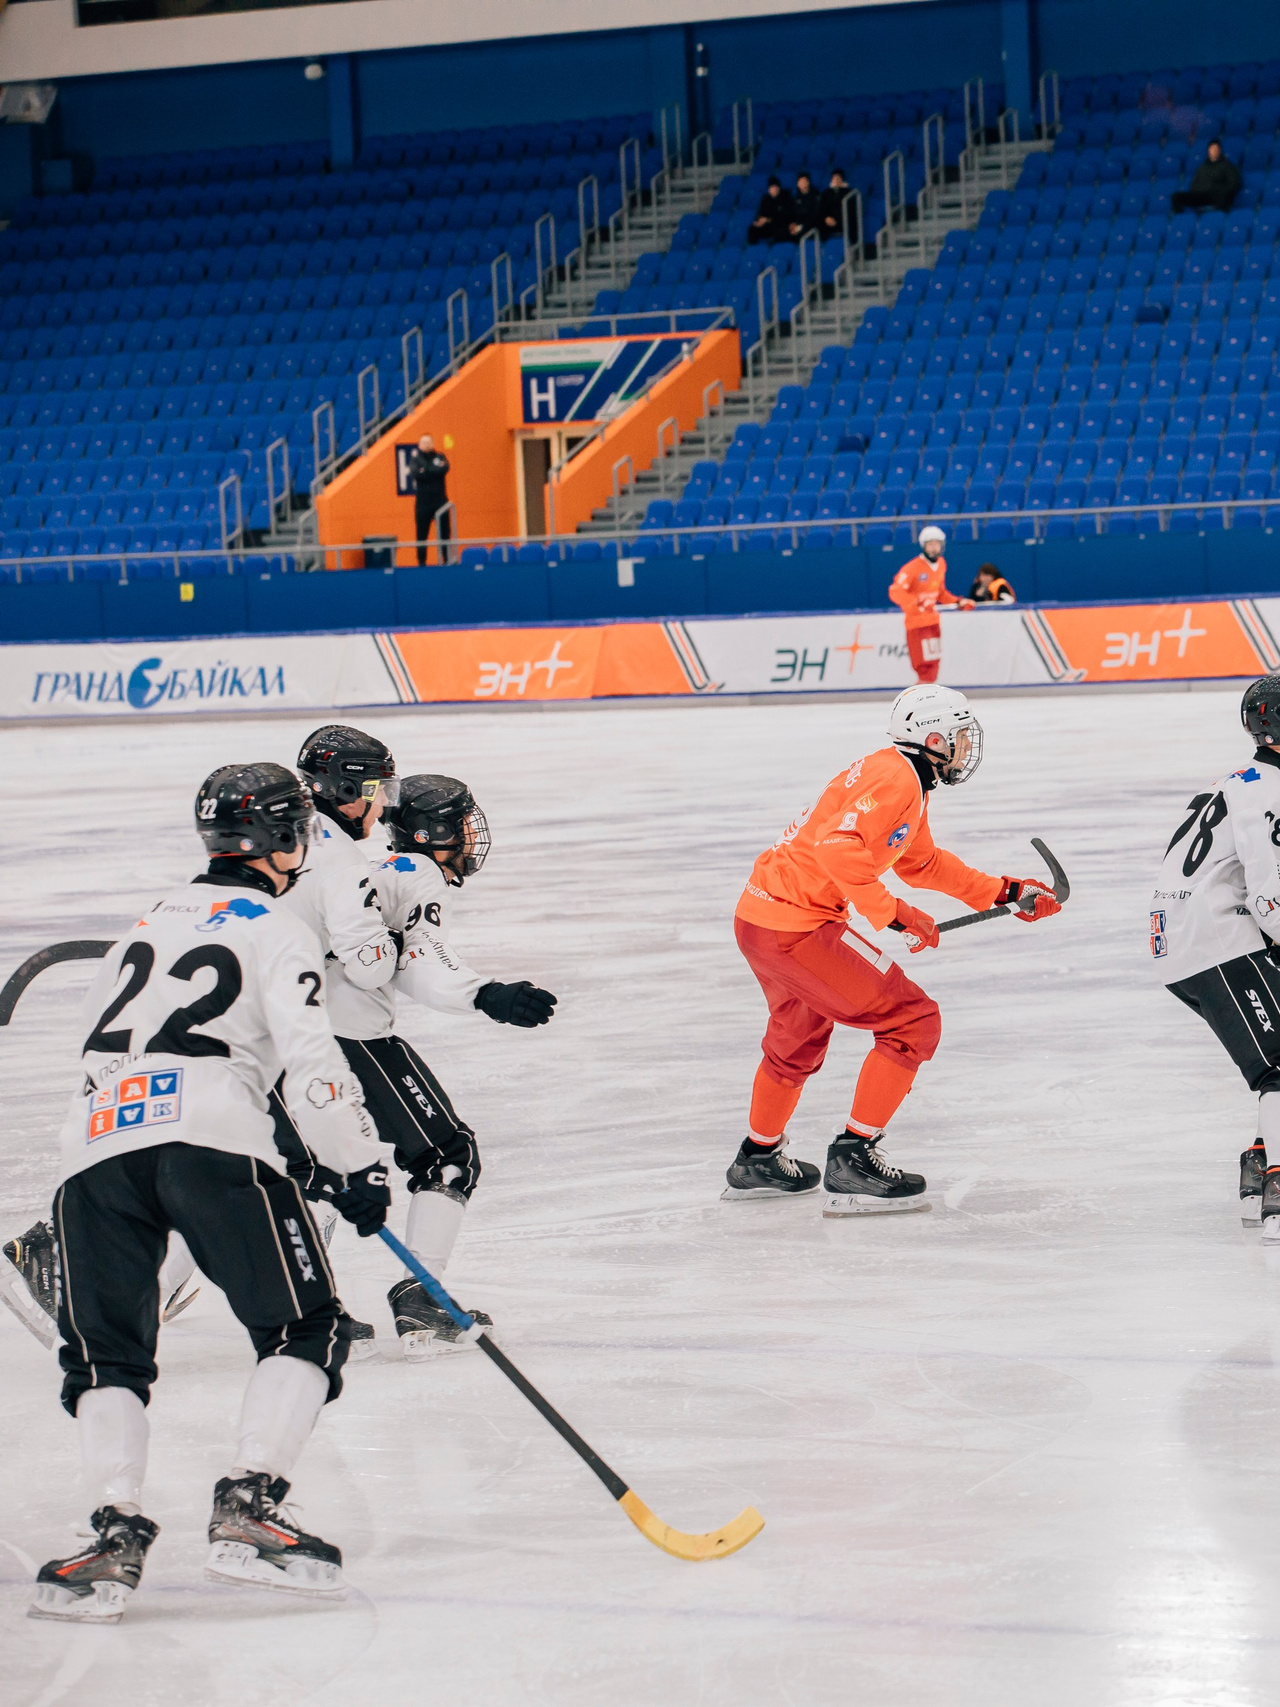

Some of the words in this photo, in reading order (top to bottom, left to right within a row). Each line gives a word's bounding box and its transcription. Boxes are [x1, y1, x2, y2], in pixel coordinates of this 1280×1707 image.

[32, 671, 125, 703] ГРАНД
[168, 660, 285, 700] БАЙКАЛ
[920, 718, 940, 726] CCM
[200, 798, 217, 820] 22
[1163, 790, 1228, 877] 78
[405, 902, 441, 931] 96
[82, 942, 242, 1058] 22
[1245, 988, 1274, 1033] STEX
[401, 1075, 437, 1119] STEX
[283, 1217, 317, 1282] STEX
